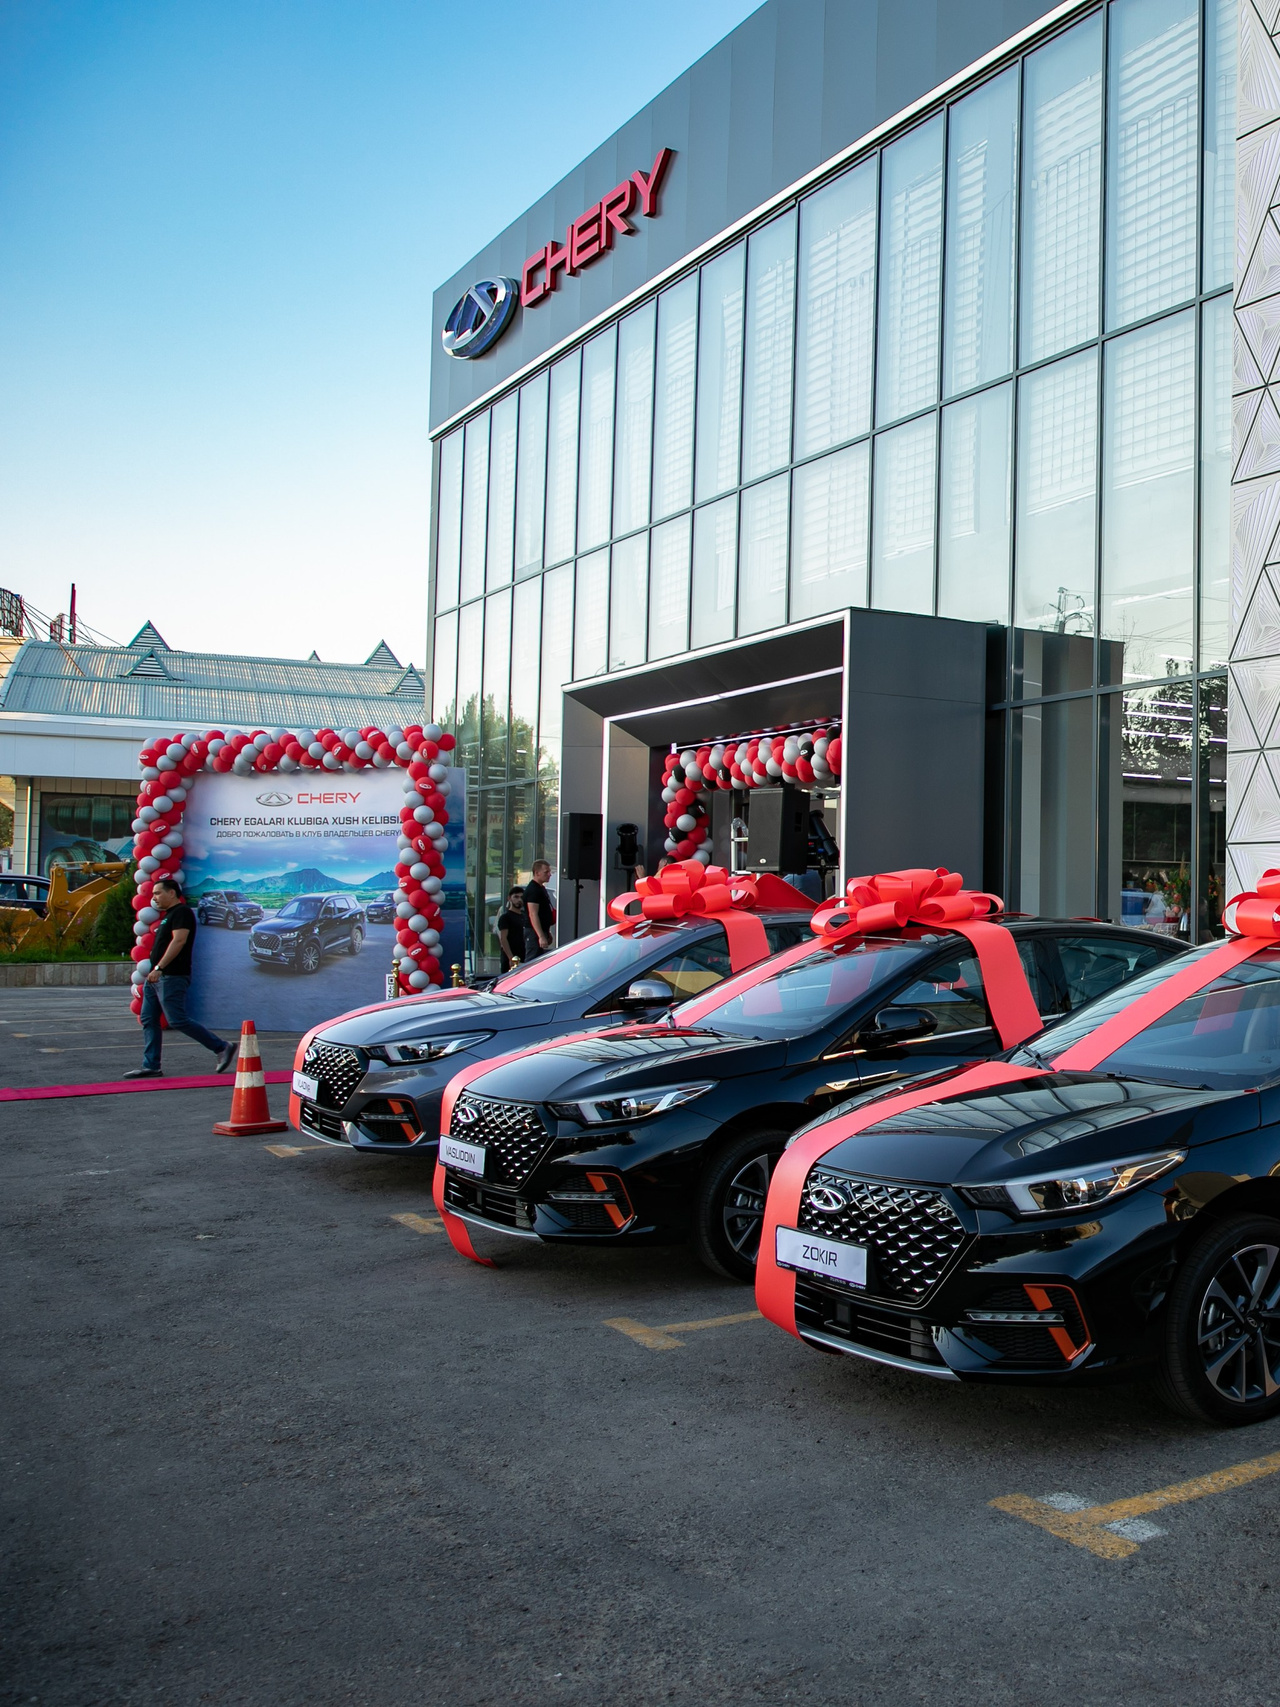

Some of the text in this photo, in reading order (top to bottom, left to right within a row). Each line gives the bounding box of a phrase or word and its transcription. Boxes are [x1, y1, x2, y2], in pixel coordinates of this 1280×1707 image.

[521, 147, 676, 307] CHERY
[297, 791, 361, 804] CHERY
[210, 817, 241, 826] CHERY
[244, 817, 285, 826] EGALARI
[287, 816, 329, 825] KLUBIGA
[332, 816, 359, 825] XUSH
[216, 830, 242, 839] ДОБРО
[243, 830, 294, 838] ПОЖАЛОВАТЬ
[295, 830, 301, 838] В
[323, 829, 373, 838] ВЛАДЕЛЬЦЕВ
[802, 1244, 838, 1267] ZOKIR
